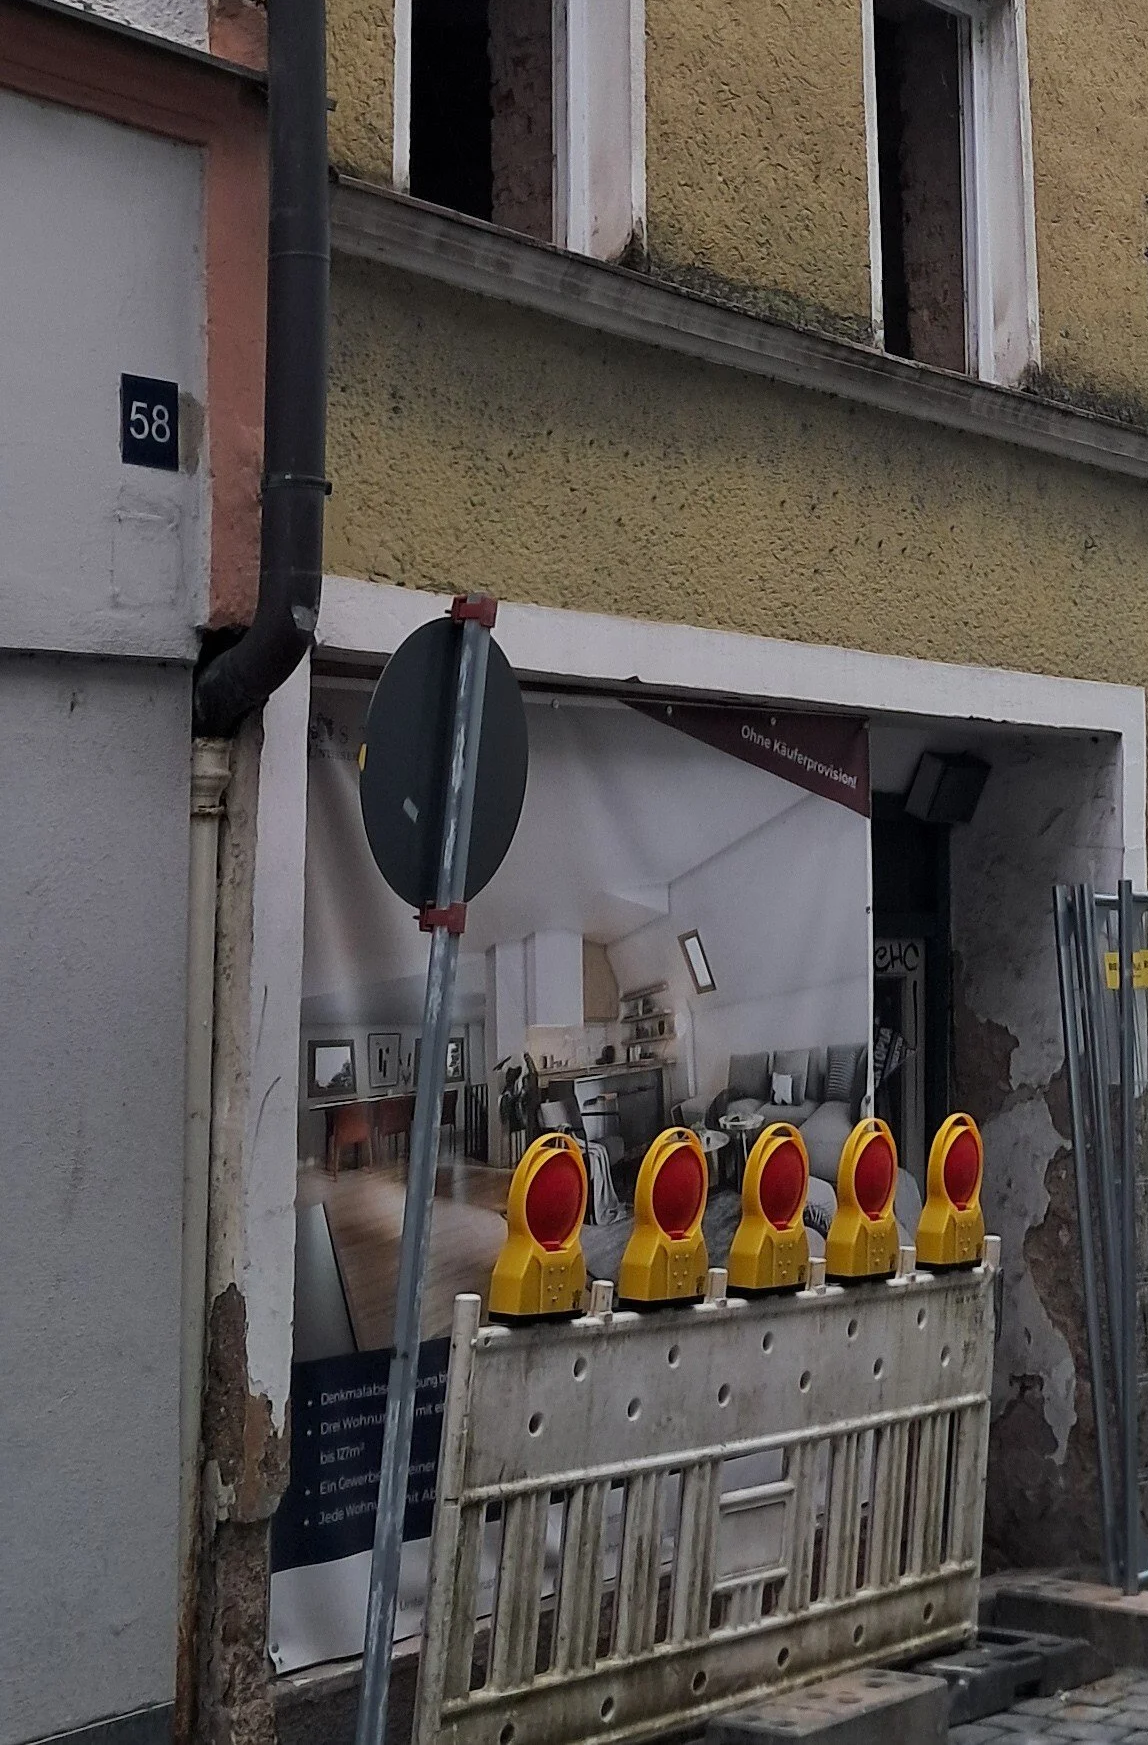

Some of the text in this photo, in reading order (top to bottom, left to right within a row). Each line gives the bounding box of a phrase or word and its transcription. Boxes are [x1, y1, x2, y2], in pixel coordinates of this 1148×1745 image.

[129, 401, 171, 443] 58
[740, 724, 858, 790] Ohne Käuferprovision!
[320, 1418, 341, 1435] Drei
[320, 1450, 336, 1465] bis
[319, 1480, 337, 1495] Ein
[318, 1508, 345, 1526] Jede
